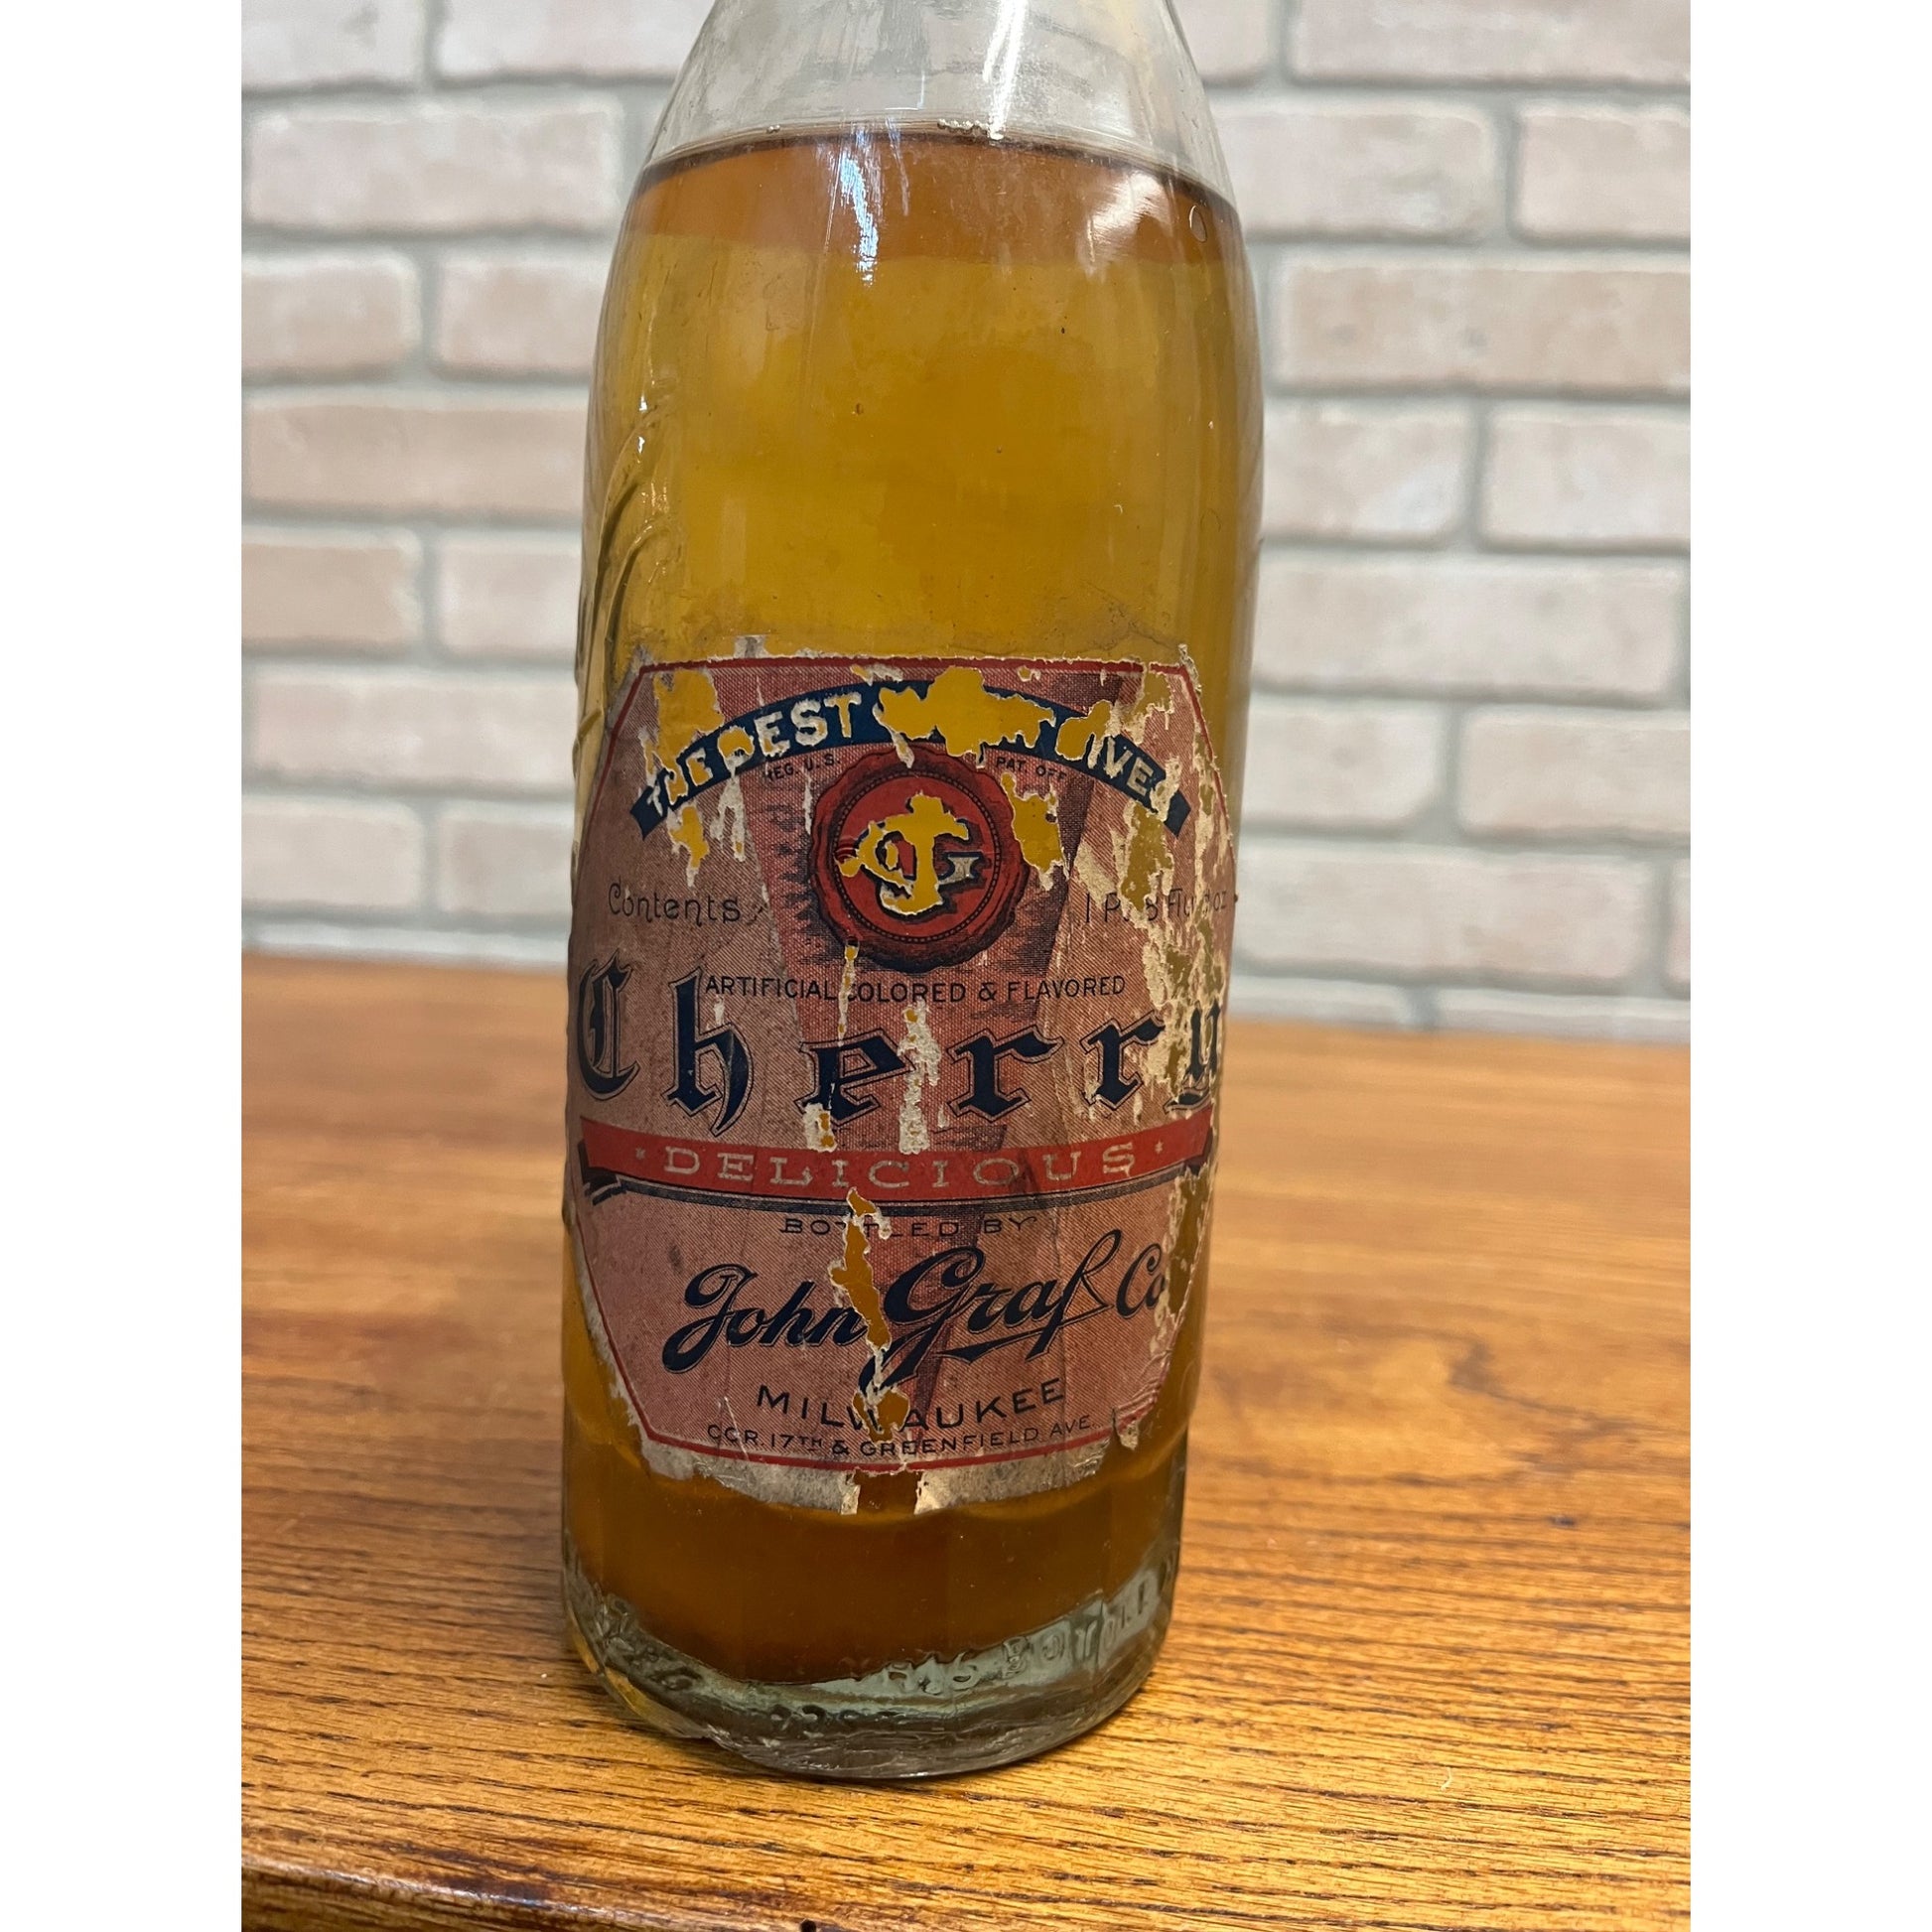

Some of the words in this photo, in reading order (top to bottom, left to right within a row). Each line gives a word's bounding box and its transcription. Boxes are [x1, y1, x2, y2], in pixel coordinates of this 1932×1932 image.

[996, 757, 1027, 774] PAT.
[609, 876, 741, 927] Contents
[705, 975, 838, 1001] ARTIFICIAL
[978, 982, 998, 1002] &
[1008, 975, 1126, 1001] FLAVORED
[577, 949, 1222, 1137] Cherry
[663, 1141, 1135, 1189] DELICIOUS
[983, 1215, 1037, 1234] BY
[662, 1263, 870, 1374] John
[858, 1228, 1115, 1398] Graf
[831, 1439, 850, 1456] &
[860, 1427, 1039, 1457] GREENFIELD
